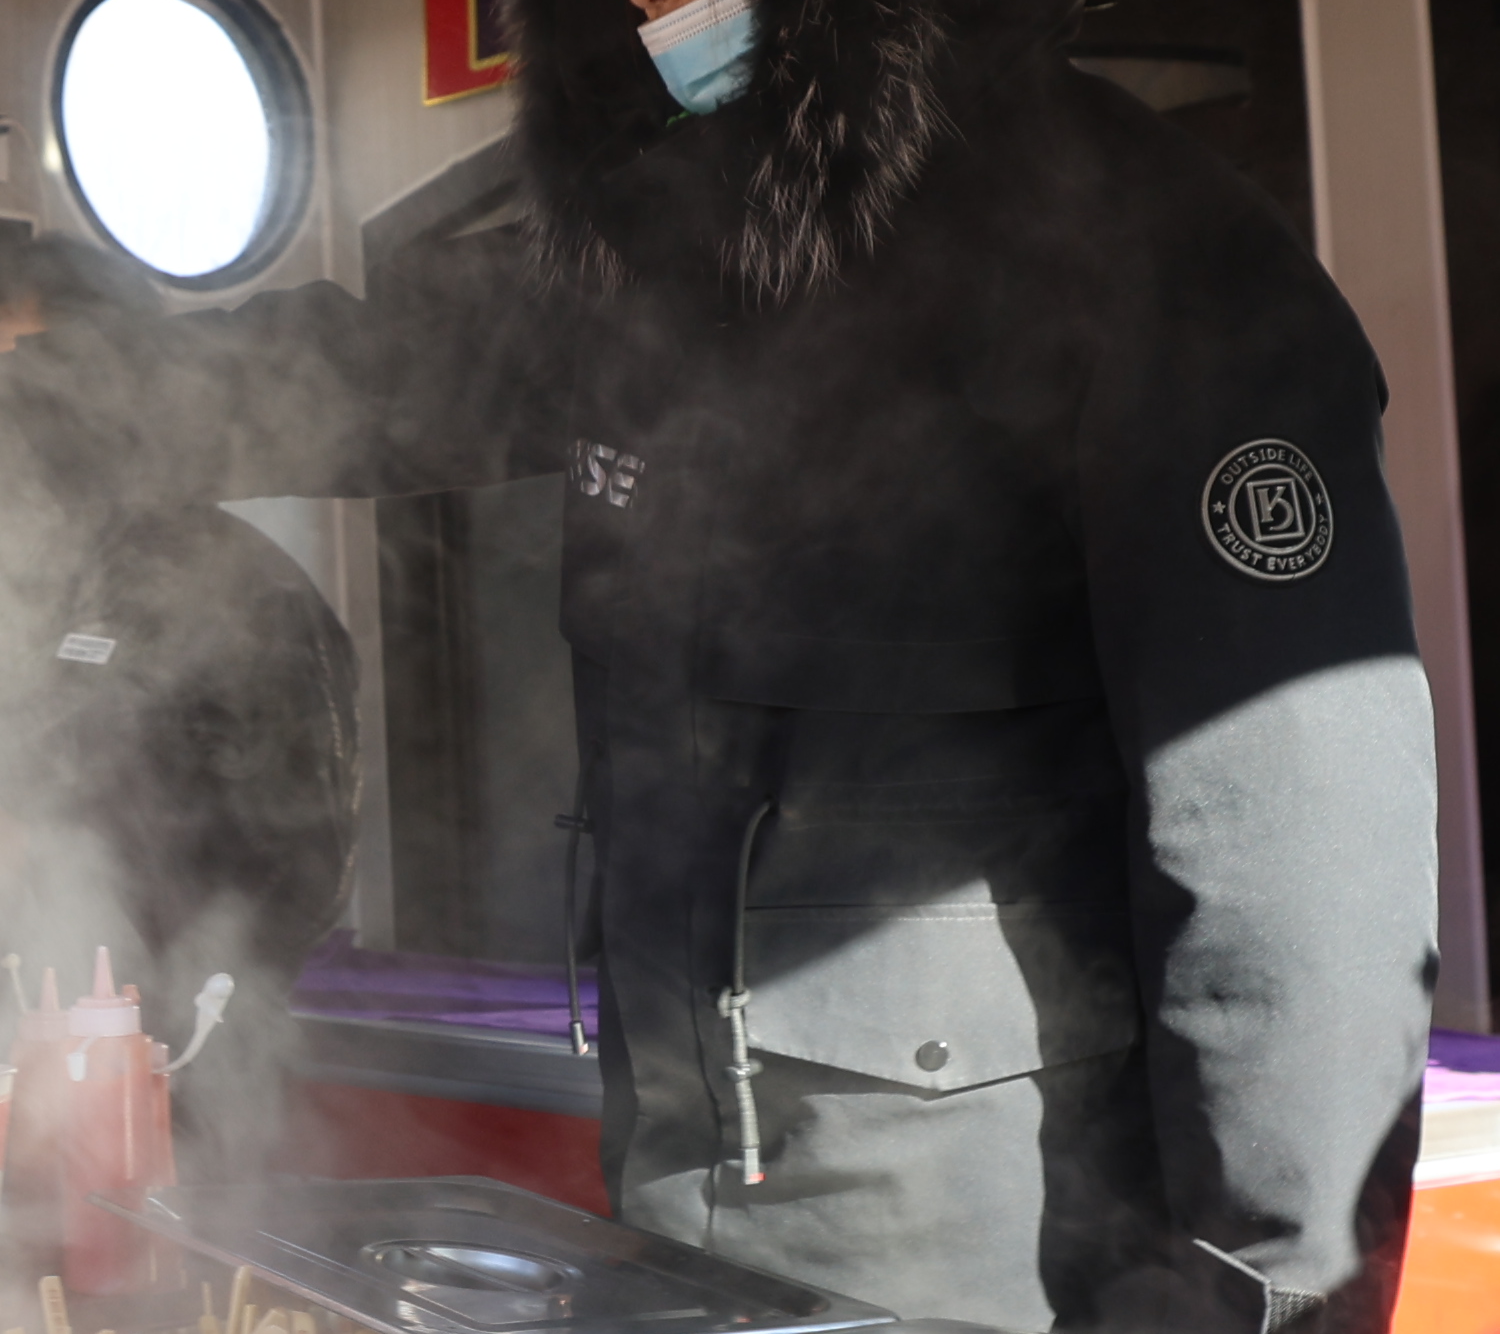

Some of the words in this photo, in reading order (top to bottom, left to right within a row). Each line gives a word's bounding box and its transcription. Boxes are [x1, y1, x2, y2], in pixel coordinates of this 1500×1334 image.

[1220, 447, 1287, 485] OUTSIDE
[1288, 453, 1314, 483] LIFE
[1217, 522, 1263, 566] TRUST
[1266, 513, 1329, 571] EVERYBODY
